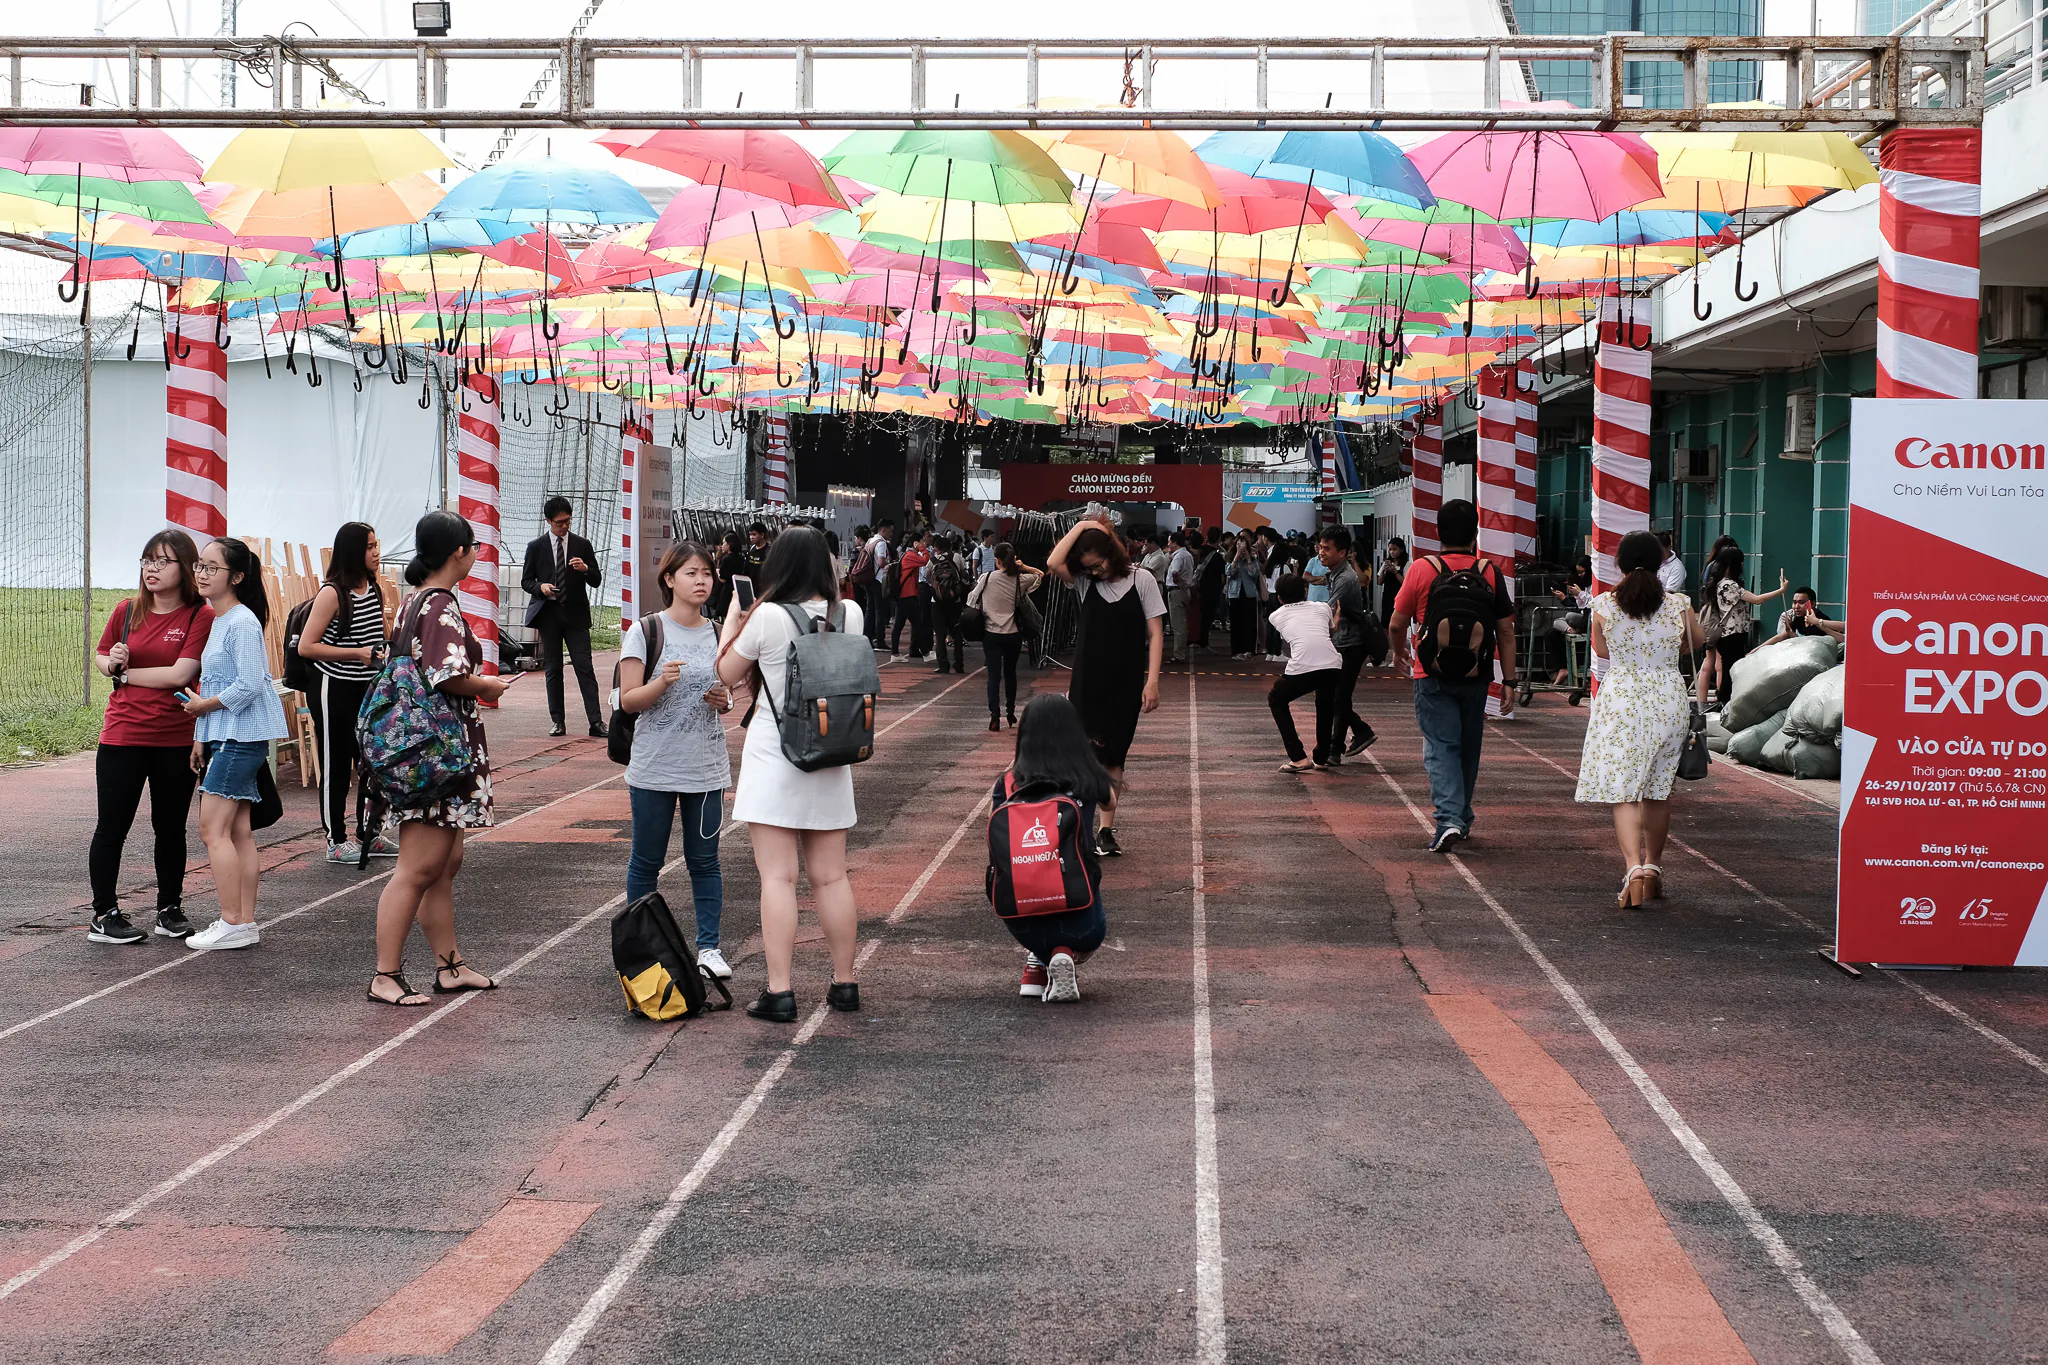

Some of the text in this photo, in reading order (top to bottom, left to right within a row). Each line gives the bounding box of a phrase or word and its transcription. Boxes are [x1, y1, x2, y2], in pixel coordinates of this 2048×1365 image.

[1895, 437, 2045, 470] Canon
[1071, 472, 1152, 483] CHÀO MỪNG ĐẾN
[1068, 485, 1155, 494] CANON EXPO 2017
[1246, 486, 1276, 497] HTV
[1893, 482, 2044, 498] Cho Niềm Vui Lan Tỏa
[1873, 590, 1893, 600] TRIỂN
[1970, 592, 1996, 602] CÔNG
[1998, 593, 2019, 603] NGHỆ
[1872, 608, 2048, 656] Canon
[1905, 668, 2048, 717] EXPO
[1897, 735, 2047, 760] VÀO CỬA TỰ DO
[1912, 766, 1935, 777] Thời
[1937, 766, 1966, 779] gian:
[1968, 767, 2001, 778] 09:00
[2013, 768, 2047, 779] 21:00
[1865, 780, 1956, 792] 26-29/10/2017
[1959, 782, 1983, 794] (Thứ
[2023, 784, 2047, 795] CN)
[1865, 797, 1880, 807] TẠI
[1882, 797, 1901, 806] SVĐ
[1904, 797, 1926, 806] HOA
[1929, 797, 1940, 806] LƯ
[1949, 798, 1965, 808] Q1,
[1967, 798, 1979, 807] TP.
[1999, 798, 2018, 808] CHÍ
[2020, 800, 2046, 809] MINH
[1921, 843, 1989, 857] Đăng ký tại:
[1865, 858, 2045, 871] www.canon.com.vn/canonexpo
[1959, 898, 1993, 920] 15
